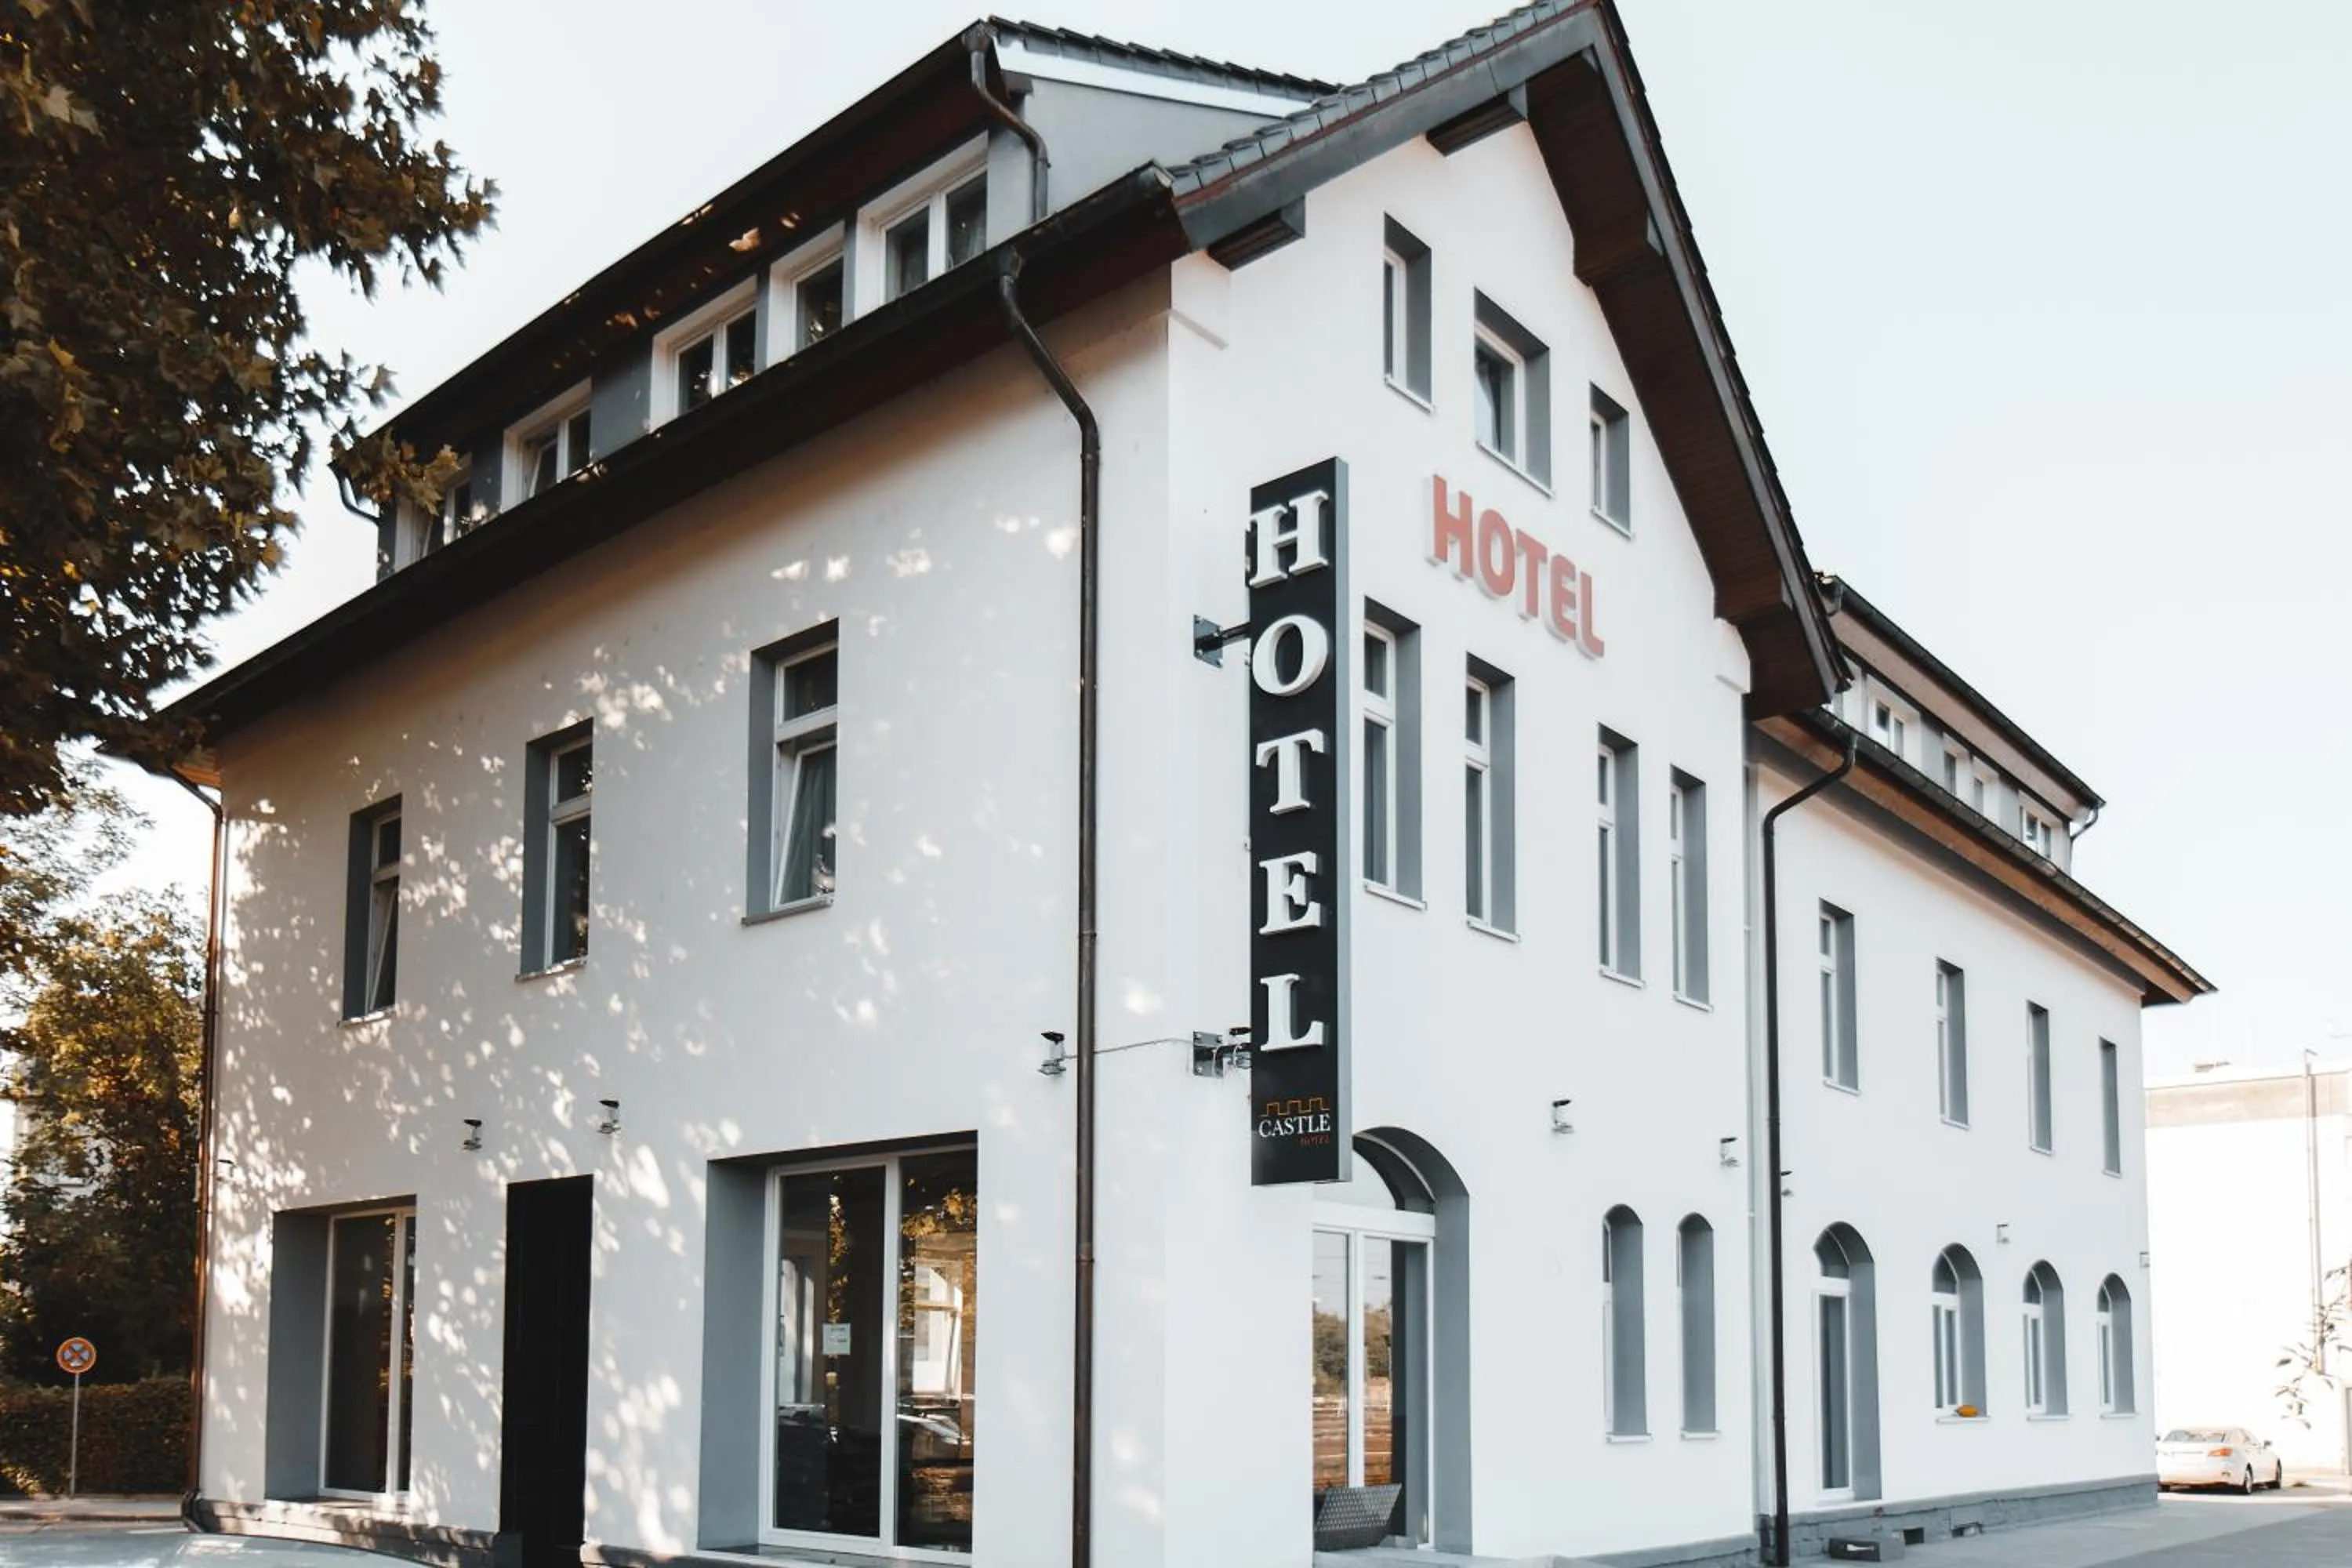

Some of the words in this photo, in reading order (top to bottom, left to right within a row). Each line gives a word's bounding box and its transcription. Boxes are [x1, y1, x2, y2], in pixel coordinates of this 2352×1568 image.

[1428, 474, 1605, 659] HOTEL
[1250, 488, 1330, 1052] HOTEL
[1258, 1113, 1330, 1138] CASTLE
